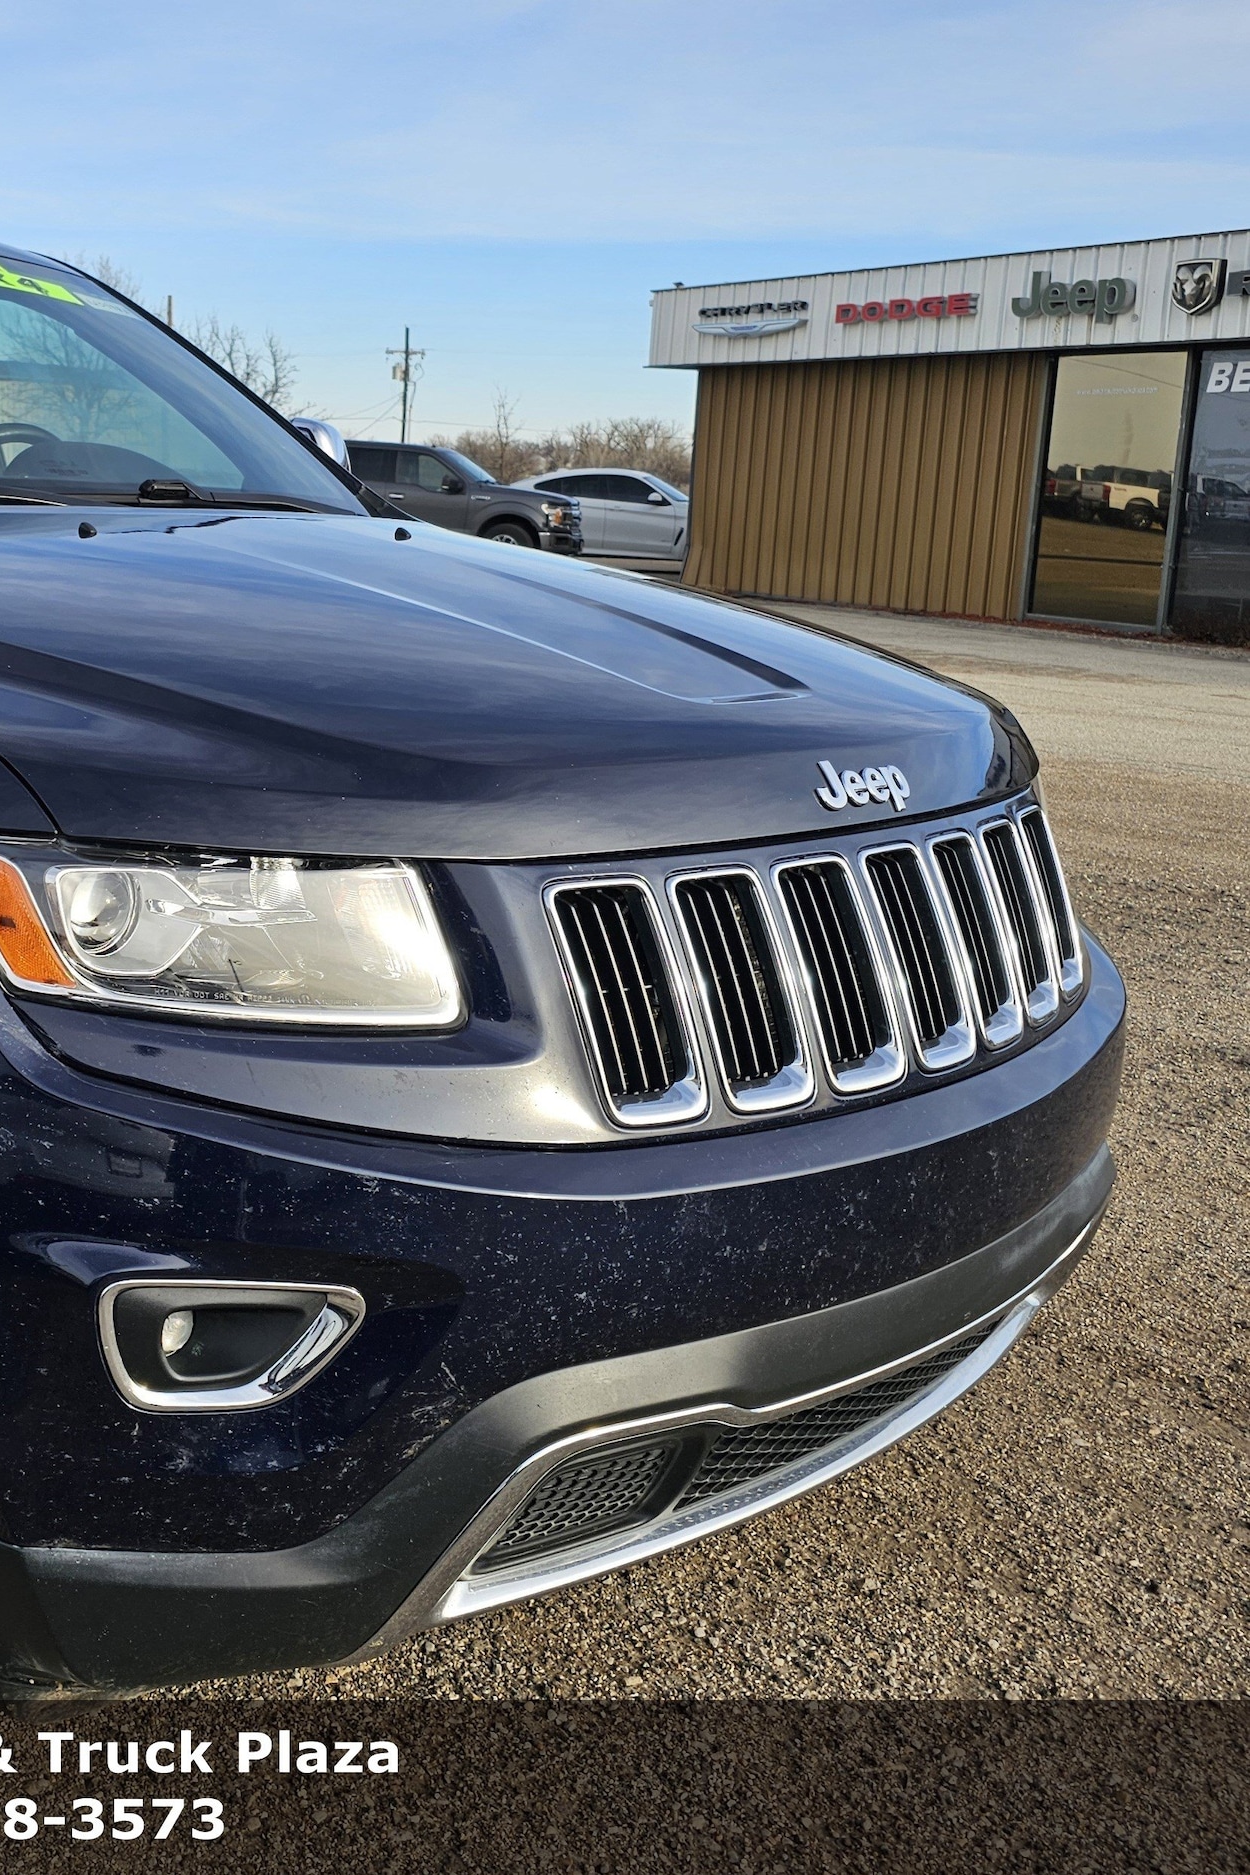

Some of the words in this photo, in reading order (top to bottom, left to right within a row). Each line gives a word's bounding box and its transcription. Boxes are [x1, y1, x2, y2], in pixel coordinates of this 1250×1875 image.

[698, 300, 809, 318] CHRYSLER
[835, 292, 980, 325] DODGE
[1010, 270, 1137, 325] Jeep
[1205, 360, 1250, 393] BE
[815, 760, 911, 811] Jeep
[194, 990, 210, 999] DOT
[213, 991, 230, 1001] SAE
